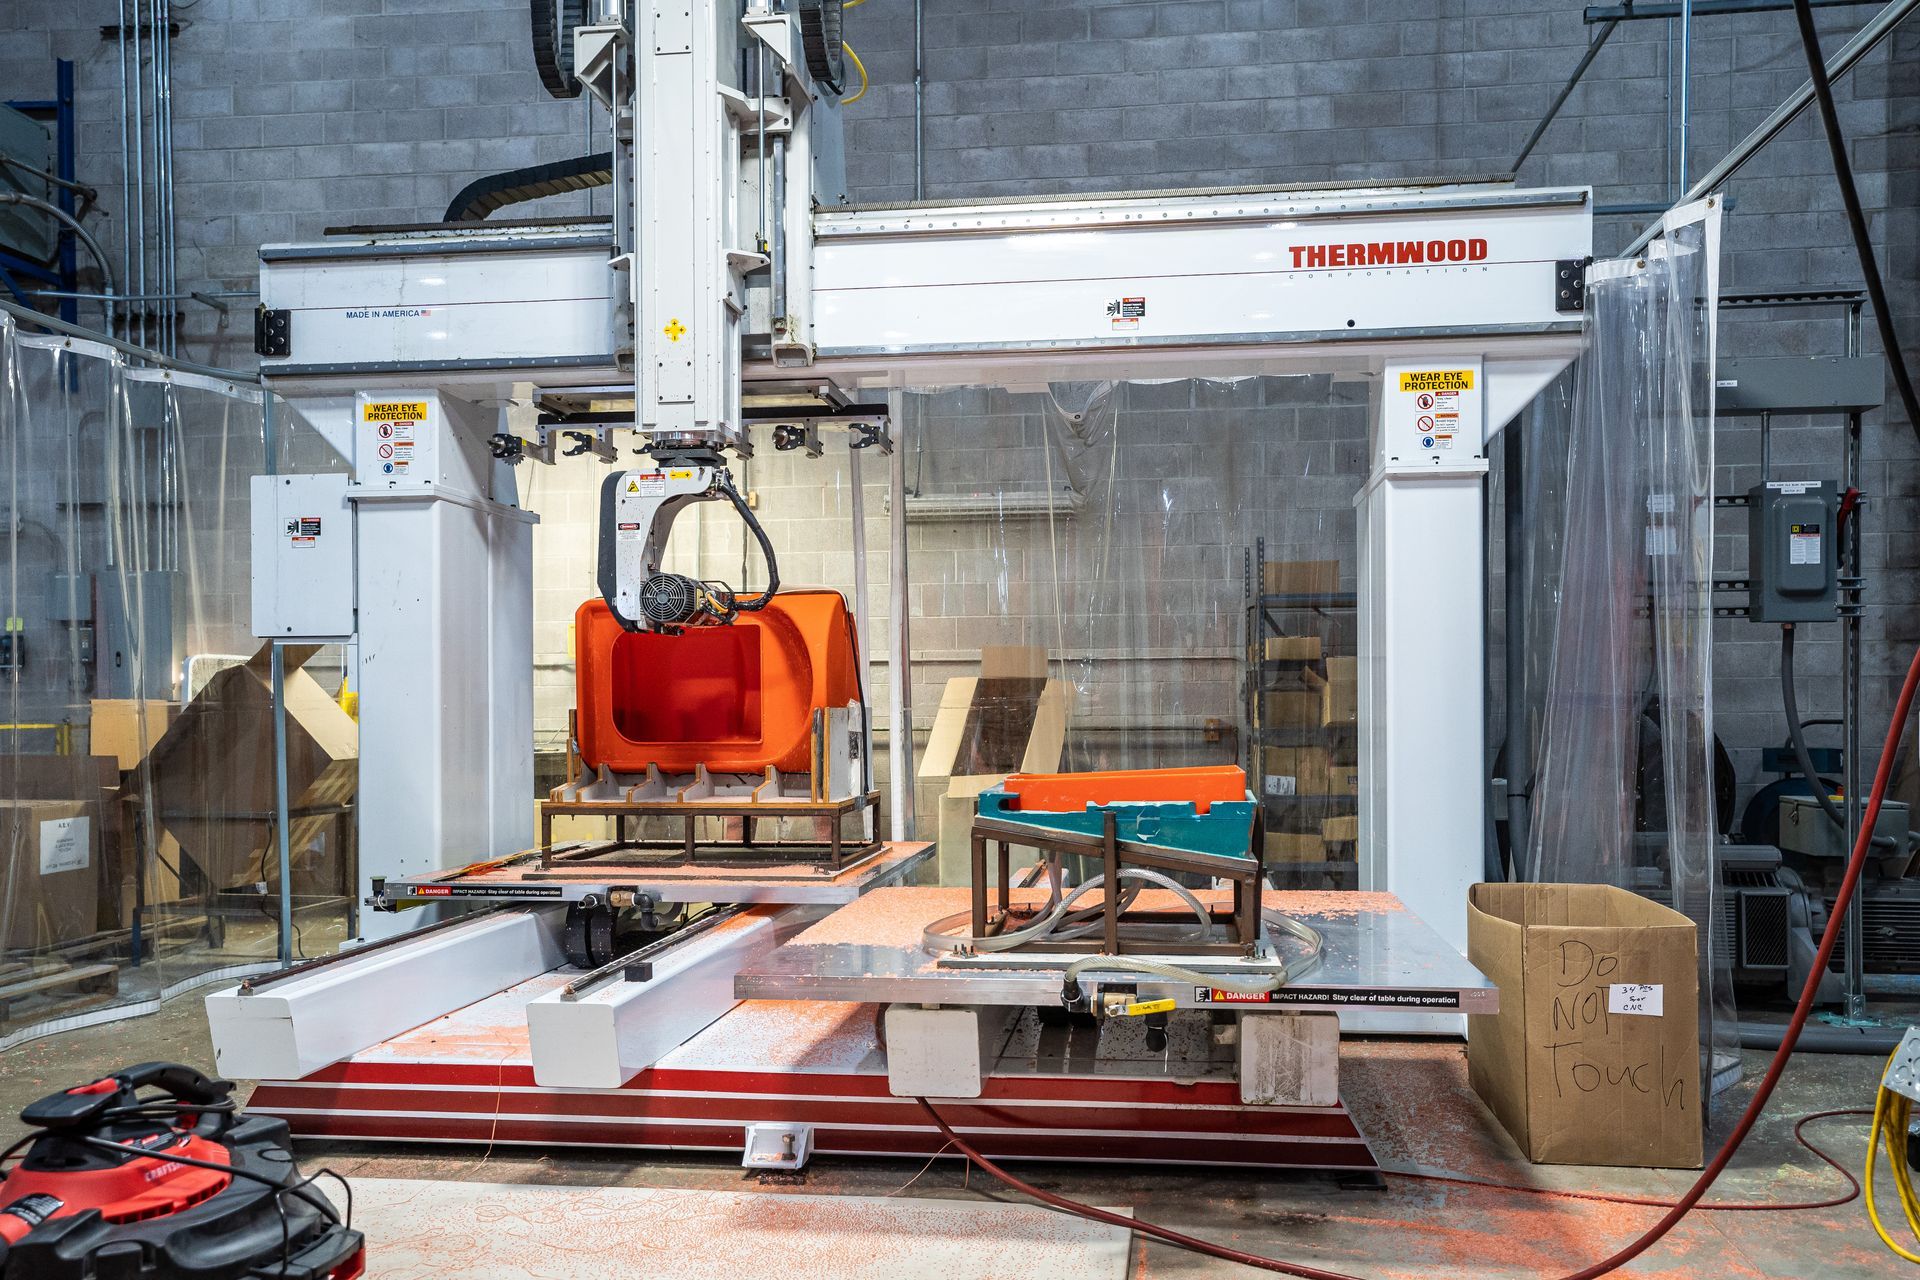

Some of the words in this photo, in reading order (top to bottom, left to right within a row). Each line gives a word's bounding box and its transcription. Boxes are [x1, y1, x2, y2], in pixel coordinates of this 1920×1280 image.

[1288, 238, 1488, 268] THERMWOOD
[346, 311, 370, 319] MADE
[371, 310, 380, 318] IN
[382, 309, 420, 318] AMERICA
[1410, 373, 1441, 381] WEAR
[1443, 372, 1463, 381] EYE
[1404, 381, 1469, 390] PROTECTION
[372, 404, 399, 412] WEAR
[401, 403, 418, 412] EYE
[367, 412, 423, 420] PROTECTION
[1556, 940, 1618, 988] Do
[1226, 992, 1266, 1000] DANGER
[1298, 993, 1330, 1001] HAZARD!
[1332, 993, 1349, 1002] Stay
[1349, 994, 1368, 1002] clear
[1368, 994, 1377, 1002] of
[1397, 995, 1421, 1004] during
[1421, 996, 1457, 1004] operation
[1552, 983, 1616, 1035] NOT
[1543, 1041, 1684, 1111] Touch
[146, 1154, 191, 1182] CRAFTS
